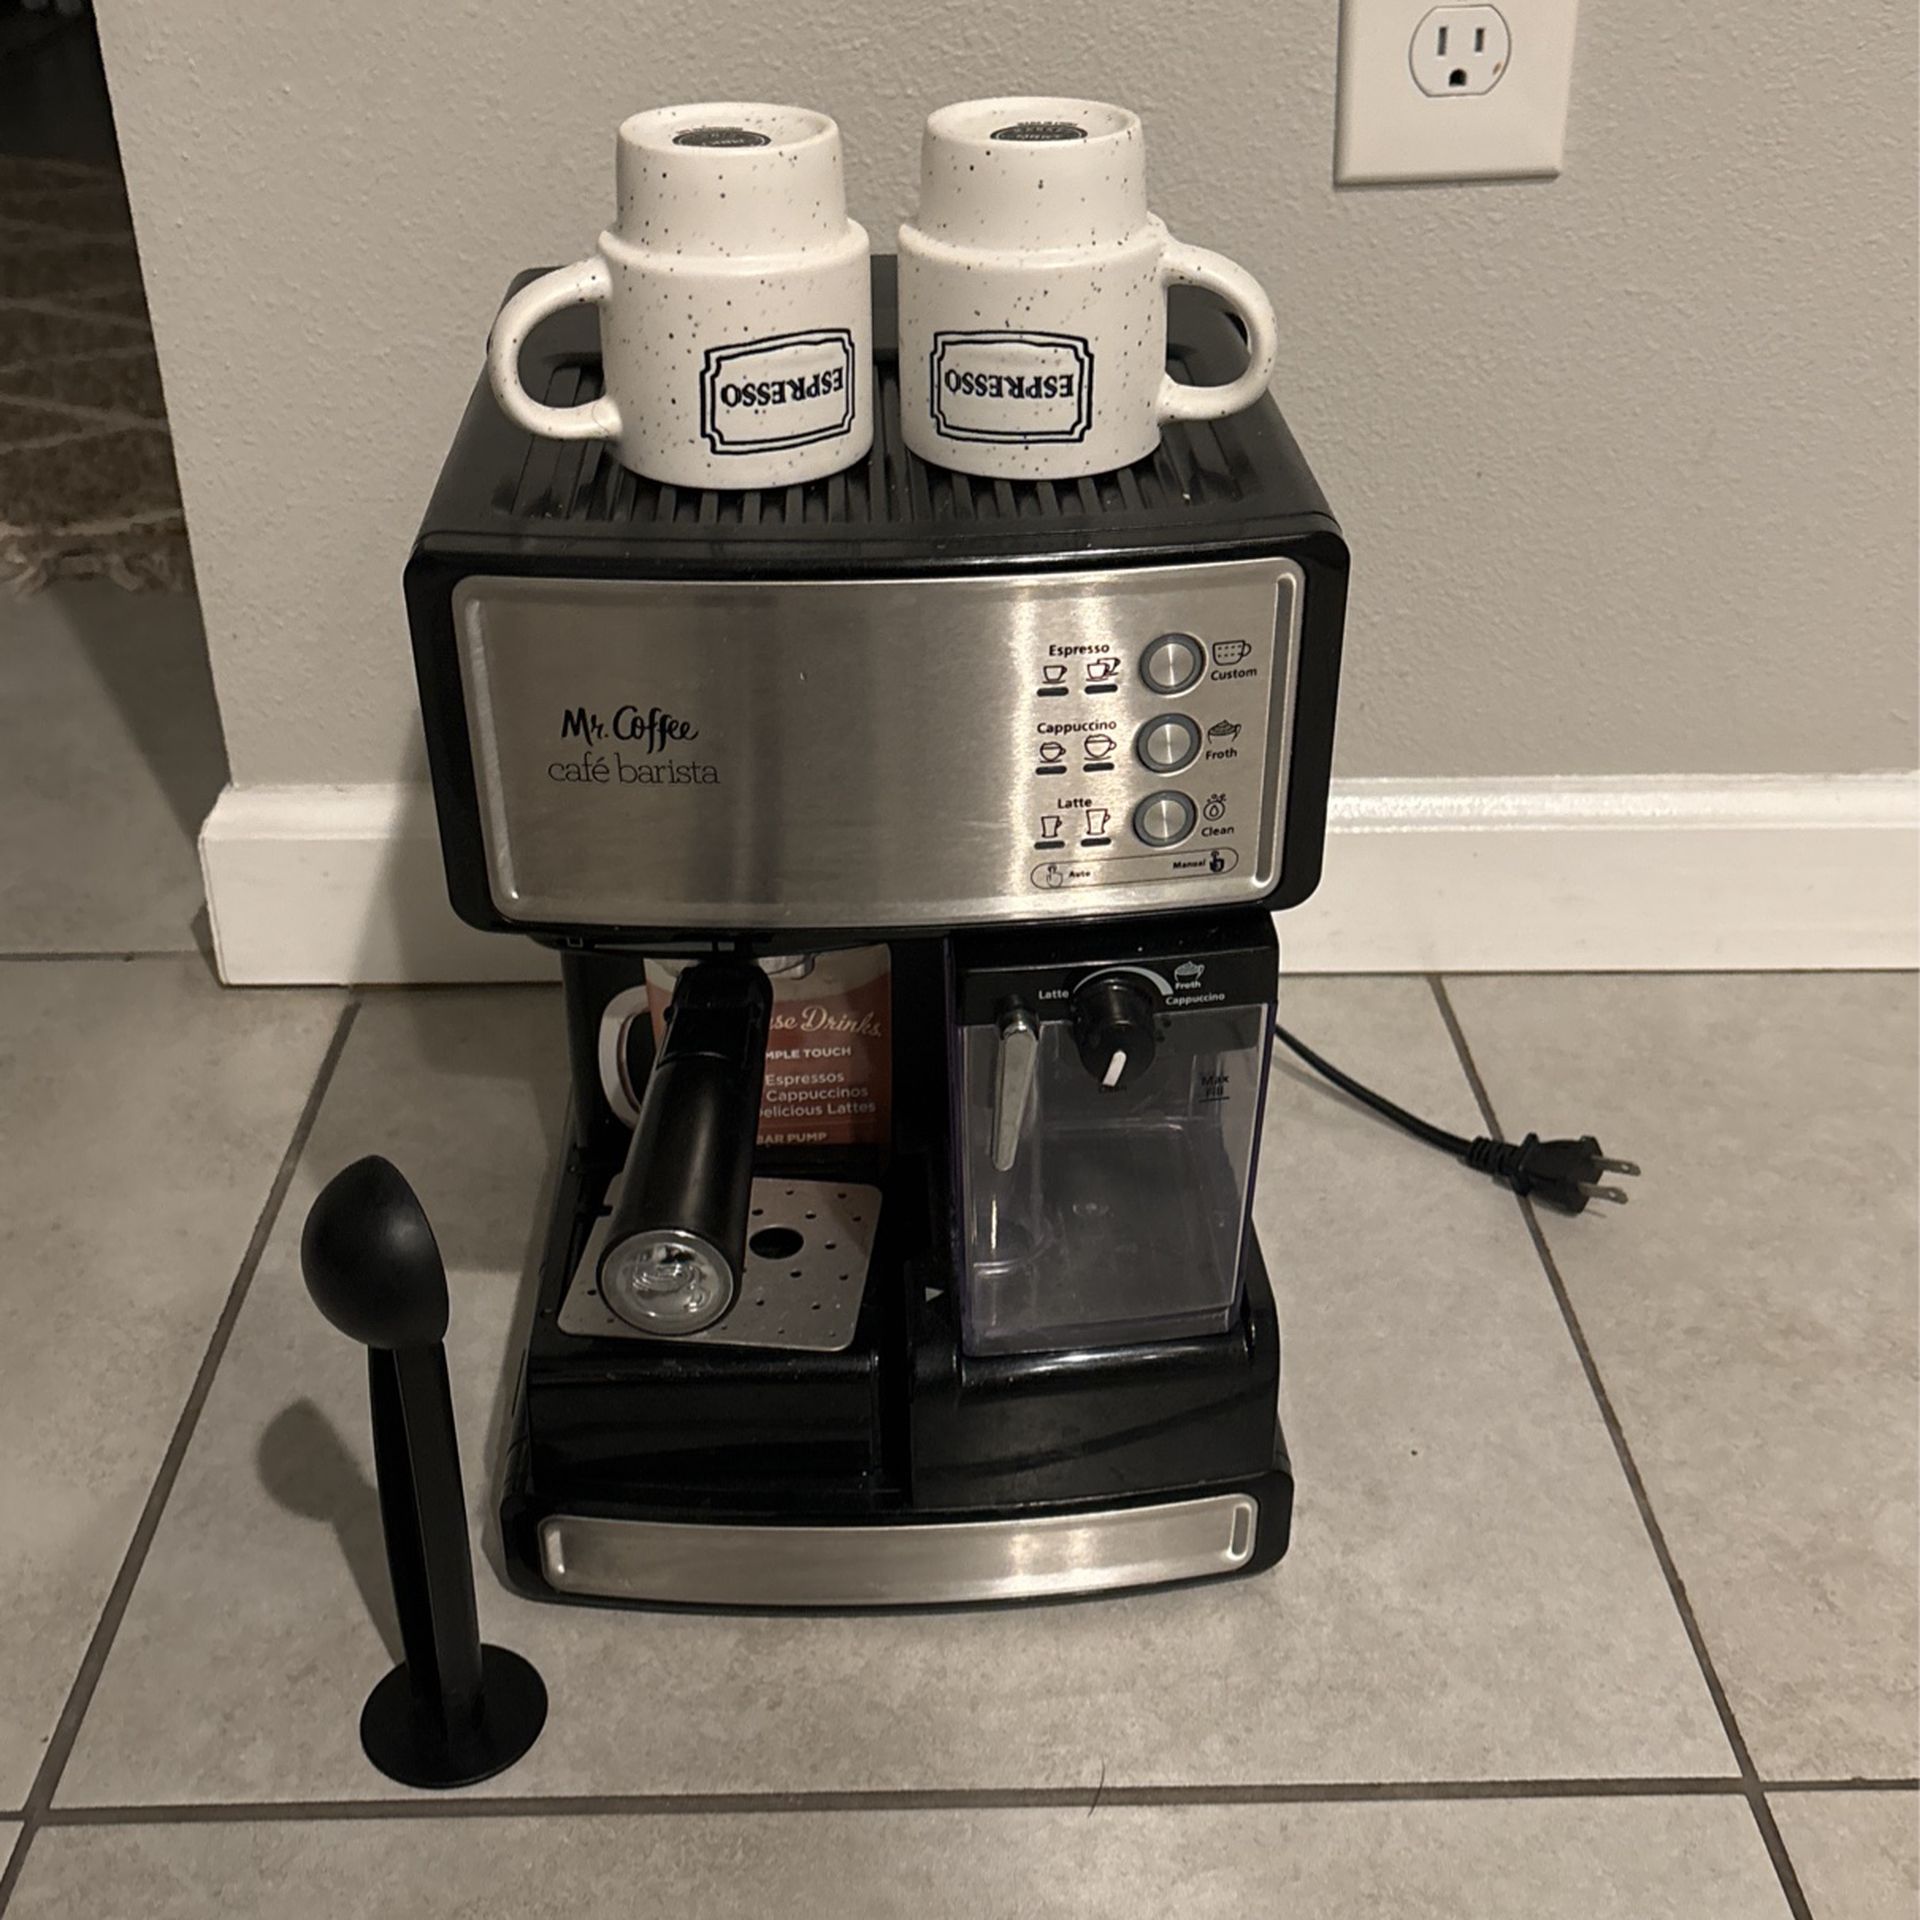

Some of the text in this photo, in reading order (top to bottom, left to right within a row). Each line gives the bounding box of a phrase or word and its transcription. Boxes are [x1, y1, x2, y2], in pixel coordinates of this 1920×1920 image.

[720, 366, 846, 408] ESPRESSO
[944, 367, 1076, 398] ESPRESSO
[1048, 643, 1110, 657] Espresso
[1210, 668, 1258, 681] Custom
[561, 705, 699, 754] Mr. Coffee
[1036, 720, 1117, 736] Cappuccino
[1205, 748, 1238, 761] Froth
[548, 751, 720, 784] café barista
[1057, 797, 1093, 810] Latte
[1201, 825, 1235, 837] Clean
[1172, 859, 1206, 870] Manual
[1068, 869, 1091, 879] Auto
[1174, 980, 1202, 991] Froth
[1038, 989, 1070, 1001] Latte
[1165, 992, 1226, 1007] Cappuccino
[803, 1046, 852, 1059] TOUCH
[765, 1072, 845, 1087] Espressos
[766, 1086, 869, 1102] Cappuccinos
[827, 1101, 876, 1115] Lattes
[787, 1132, 828, 1144] PUMP
